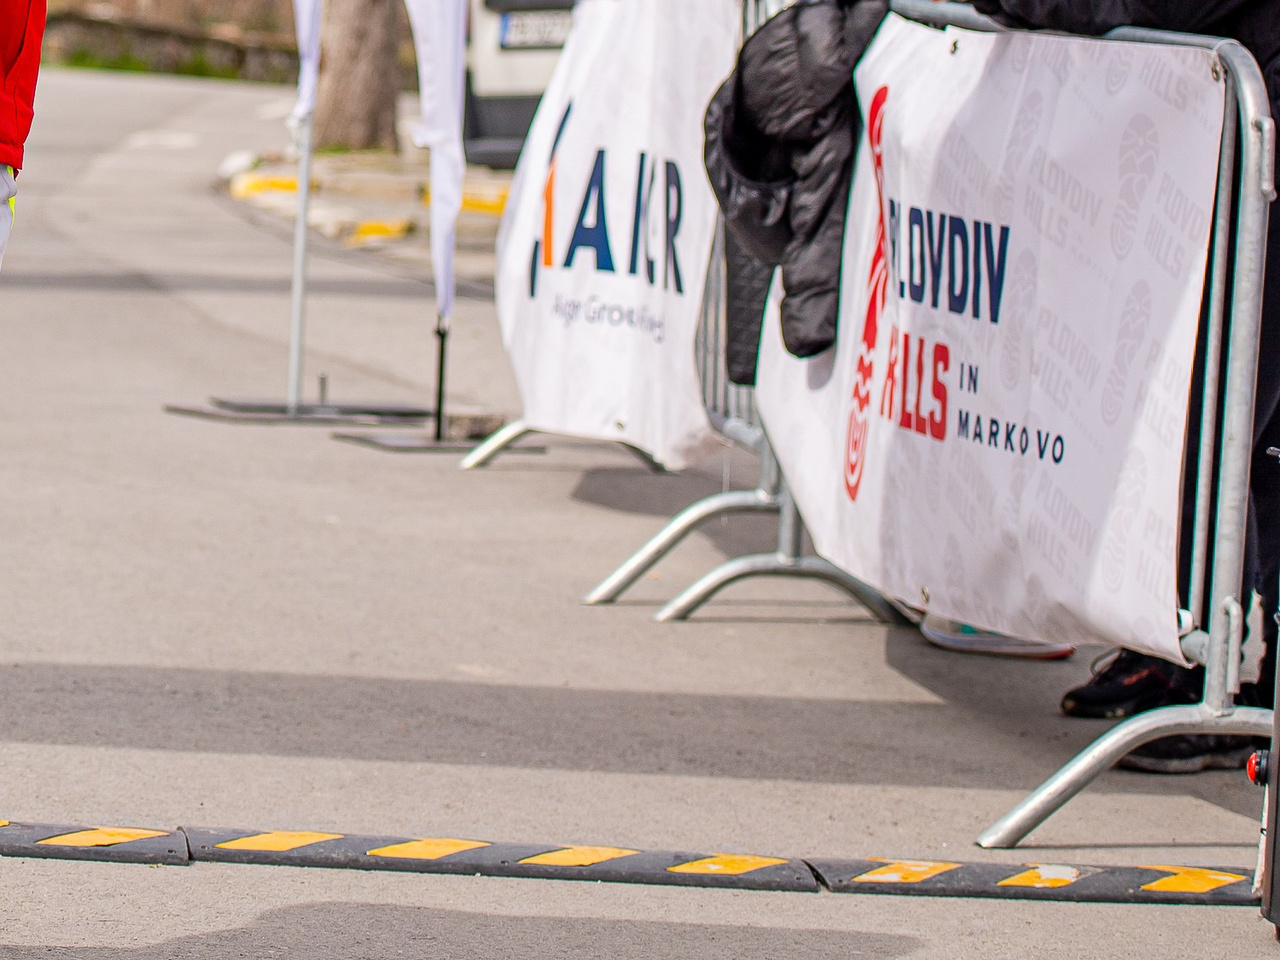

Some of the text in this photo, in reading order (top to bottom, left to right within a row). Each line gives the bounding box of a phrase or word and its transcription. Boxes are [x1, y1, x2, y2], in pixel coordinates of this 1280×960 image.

[879, 326, 950, 442] HLLS
[959, 361, 980, 395] IN
[957, 408, 1066, 466] MARKOVO
